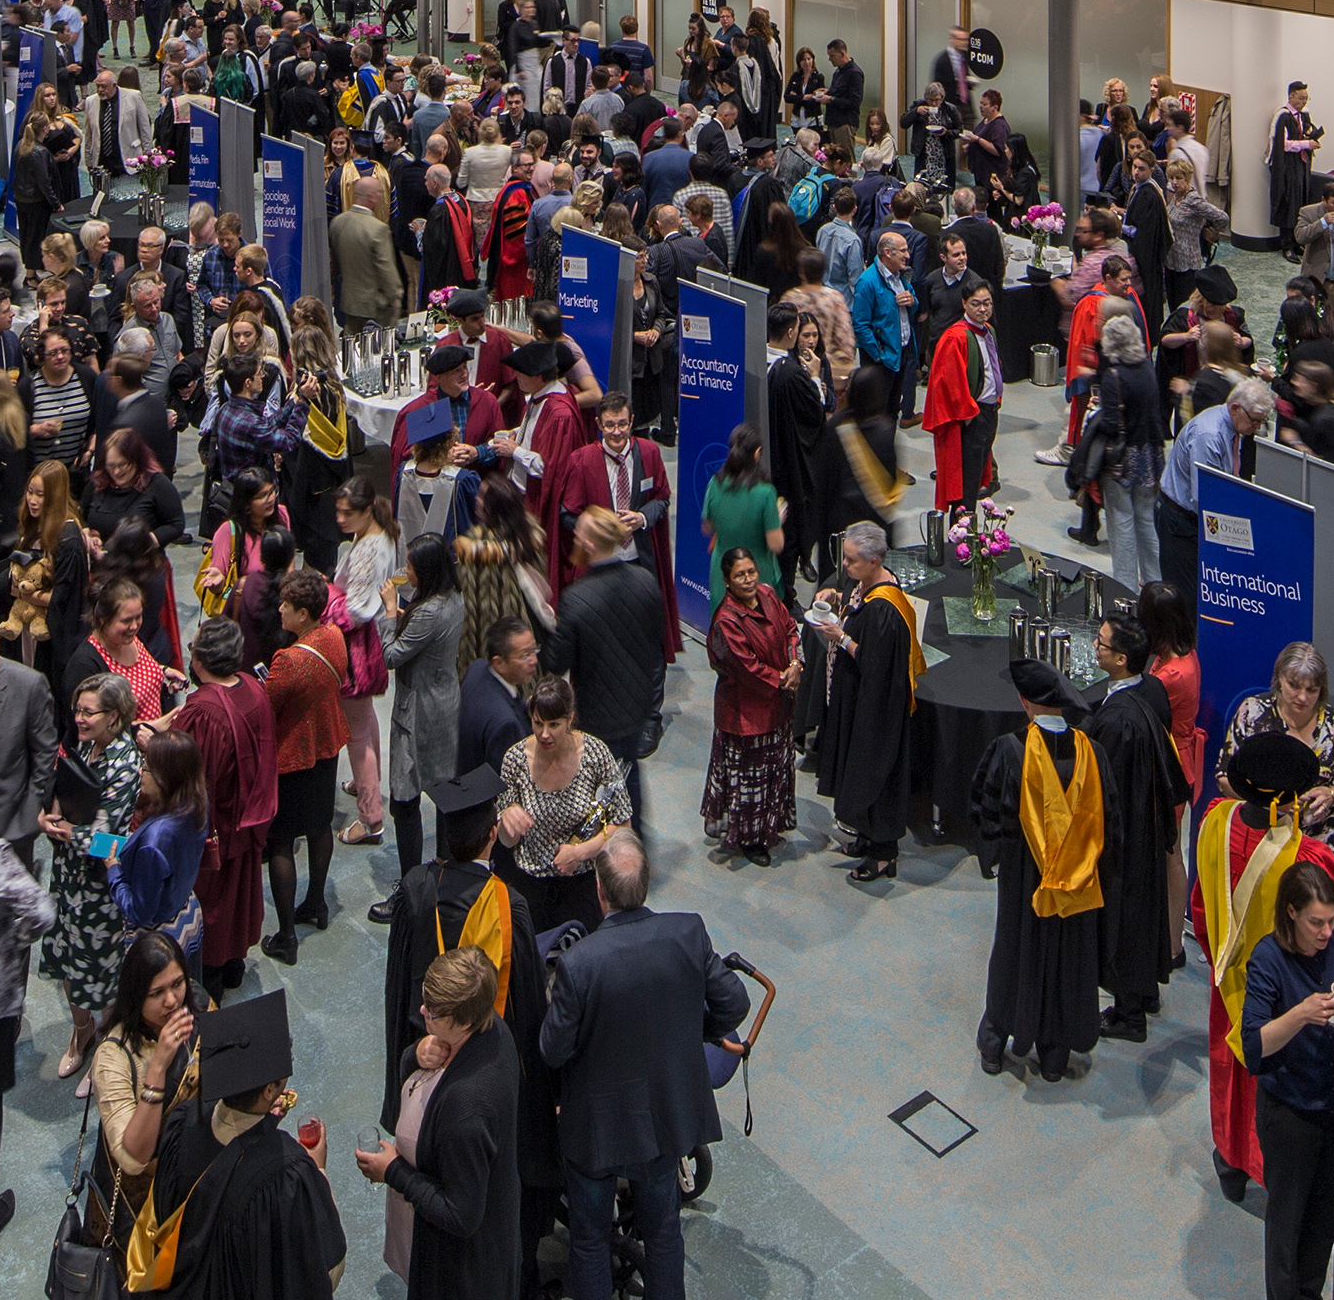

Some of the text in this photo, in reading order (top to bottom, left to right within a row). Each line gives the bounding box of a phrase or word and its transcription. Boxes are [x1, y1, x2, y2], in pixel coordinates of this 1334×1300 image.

[971, 52, 994, 65] P COM
[285, 204, 296, 216] and
[279, 217, 296, 229] Work
[559, 292, 598, 313] Marketing
[681, 354, 739, 378] Accountancy
[681, 372, 733, 391] and Finance
[1221, 523, 1249, 536] OTAGO
[1201, 561, 1301, 601] International
[1201, 582, 1266, 616] Business
